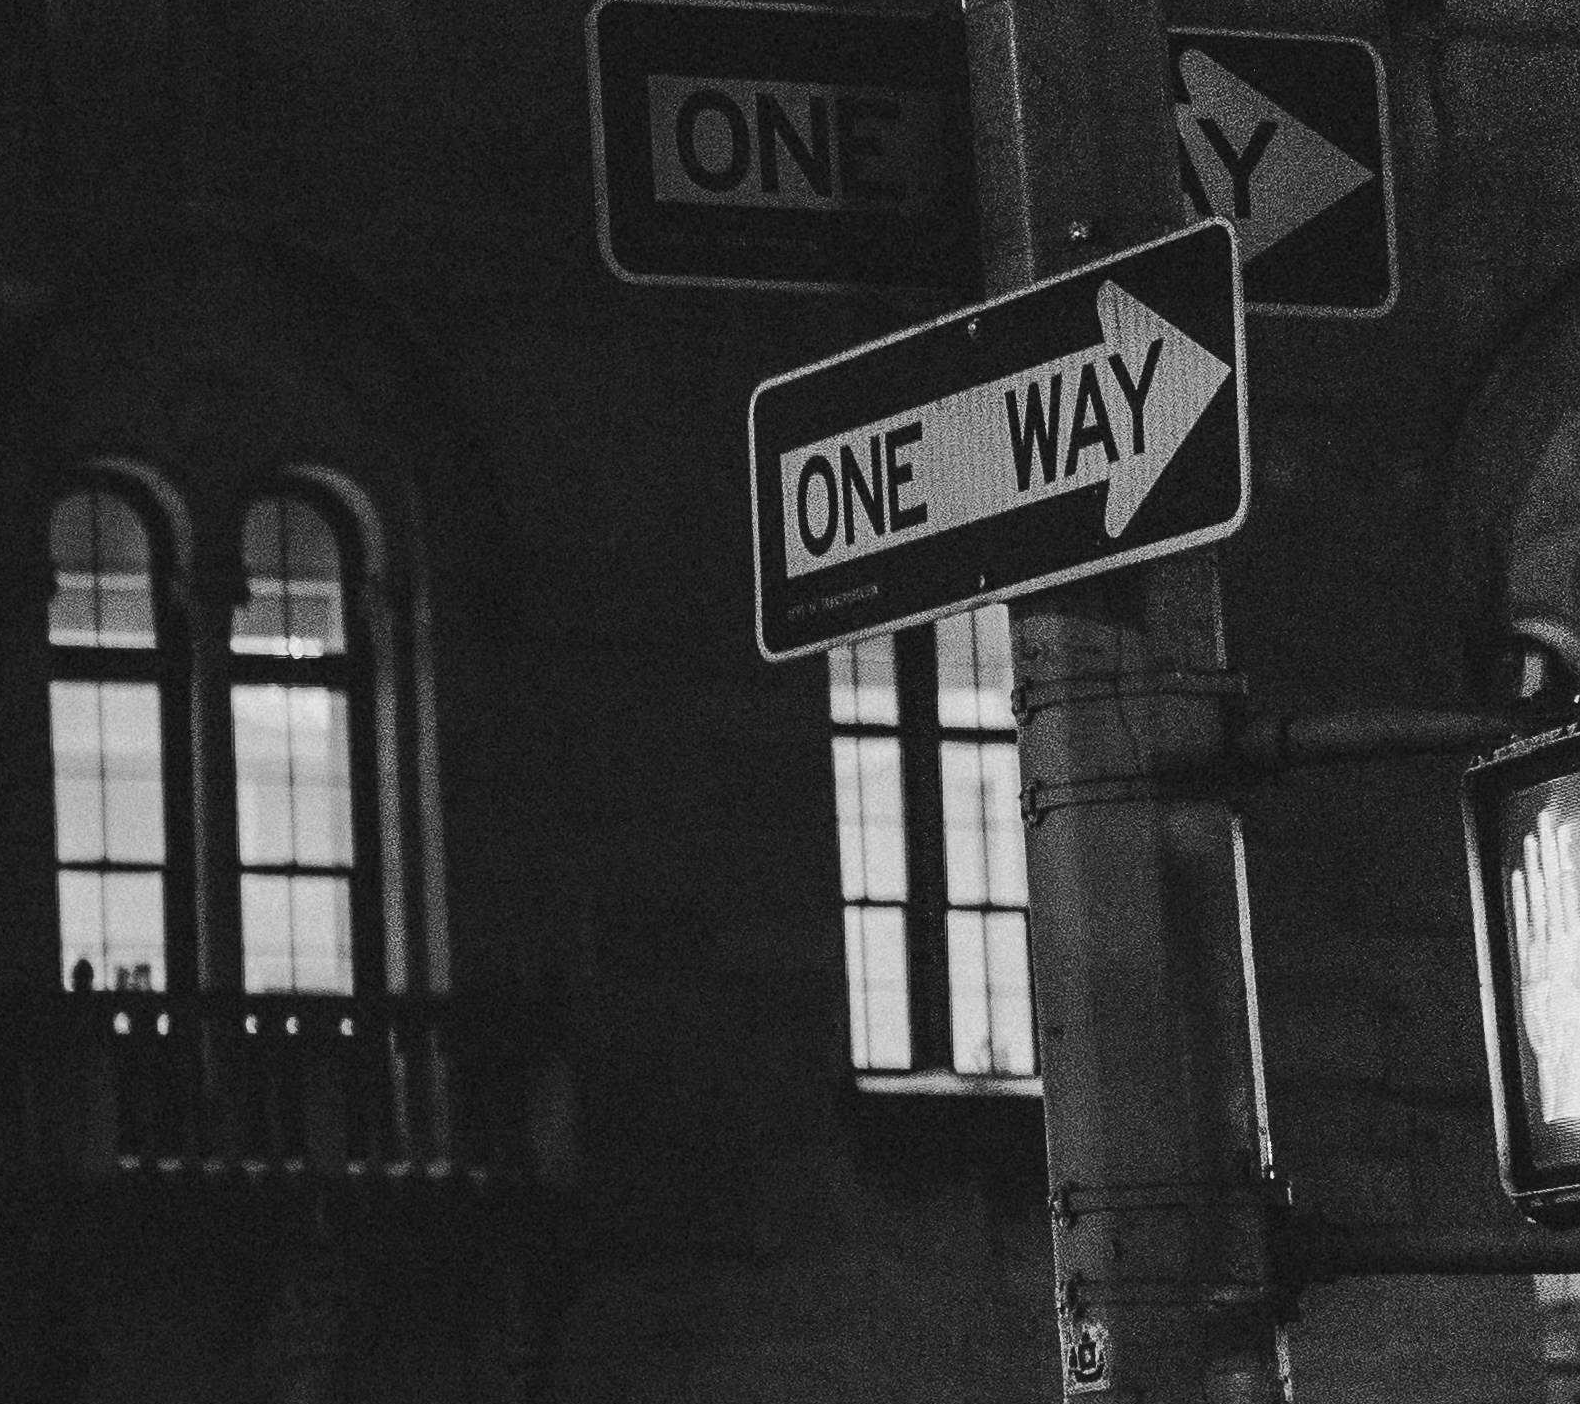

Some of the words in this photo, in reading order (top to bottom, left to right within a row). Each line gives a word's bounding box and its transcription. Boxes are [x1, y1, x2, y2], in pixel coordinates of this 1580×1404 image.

[675, 88, 902, 198] ONE
[796, 421, 929, 558] ONE
[1005, 339, 1164, 493] WAY
